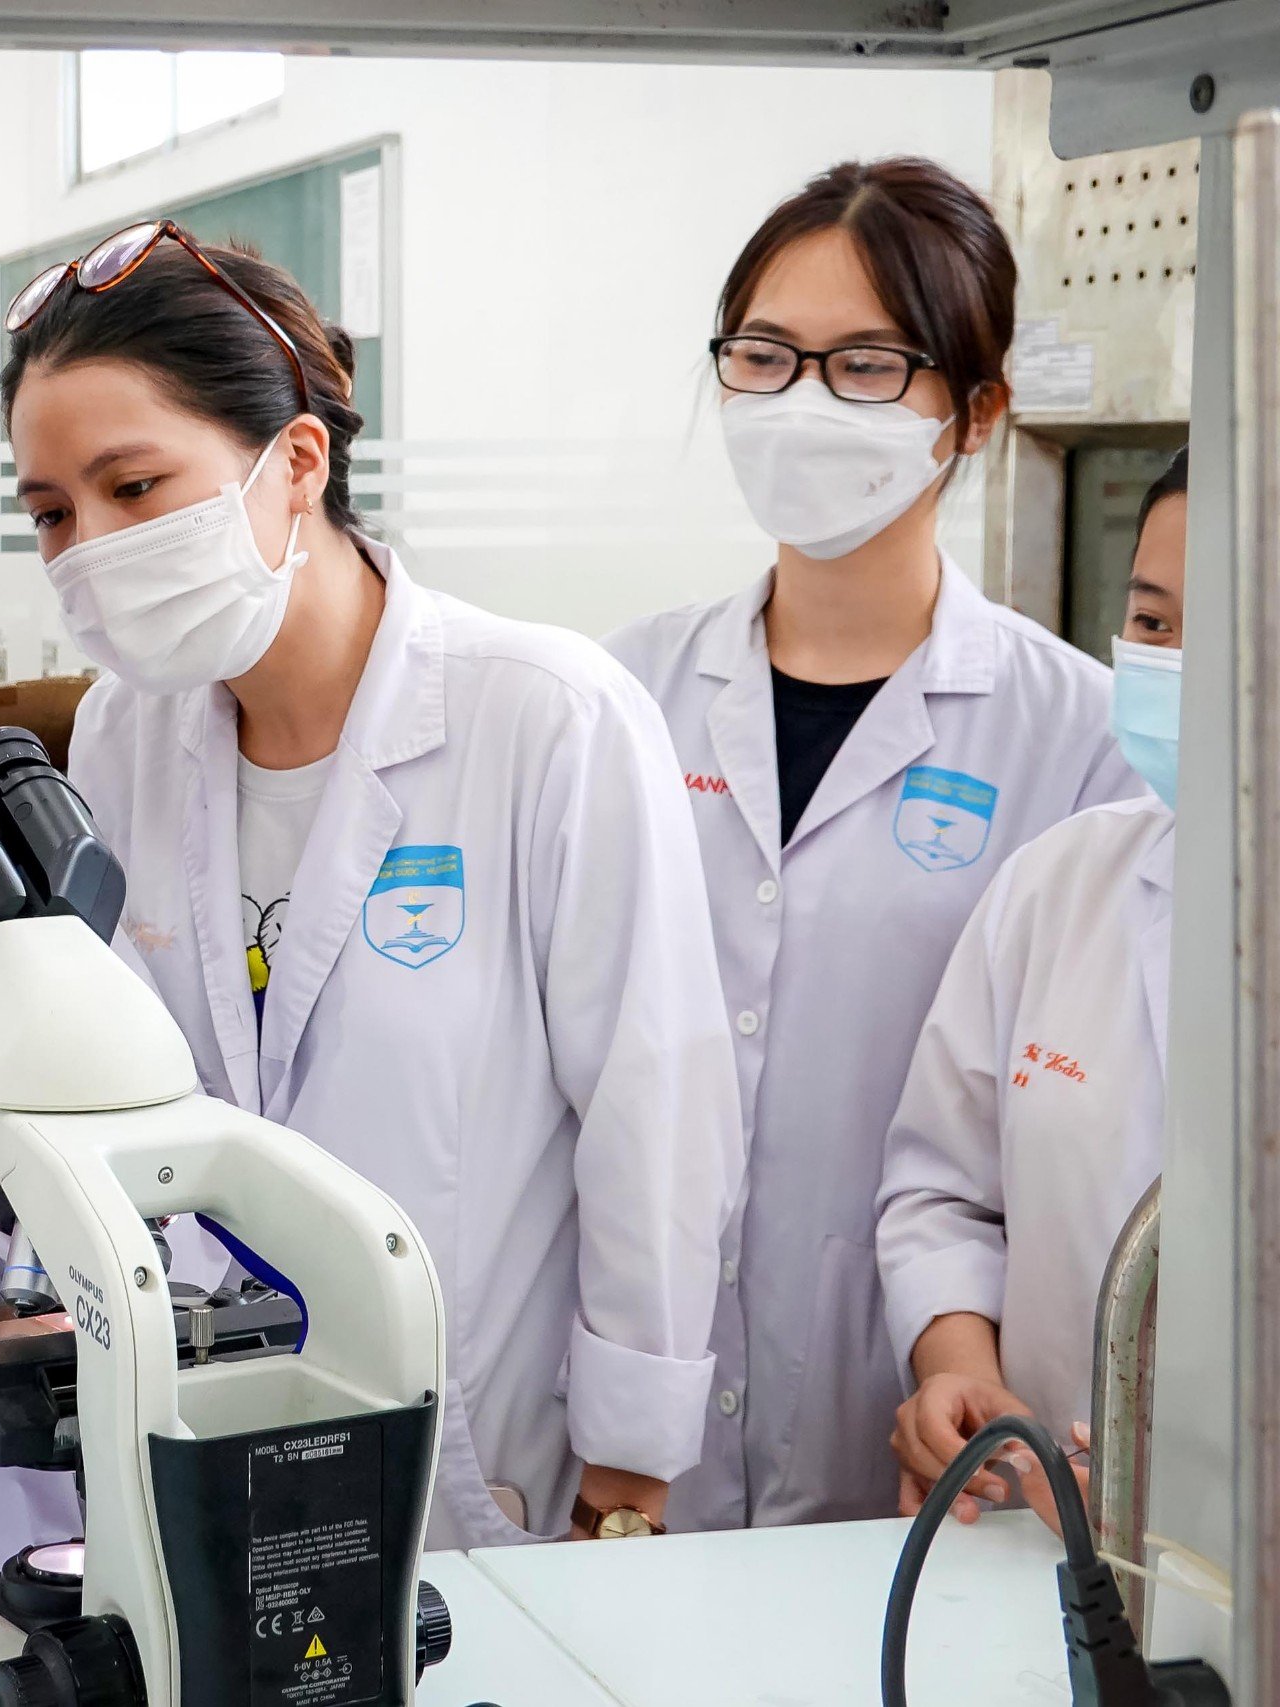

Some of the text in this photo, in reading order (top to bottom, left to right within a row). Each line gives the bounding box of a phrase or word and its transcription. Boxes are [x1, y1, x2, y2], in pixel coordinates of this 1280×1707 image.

[68, 1264, 104, 1304] OLYMPUS
[76, 1294, 111, 1351] CX23
[255, 1431, 351, 1456] MODEL CX23LEDRFS1
[287, 1451, 299, 1462] SN
